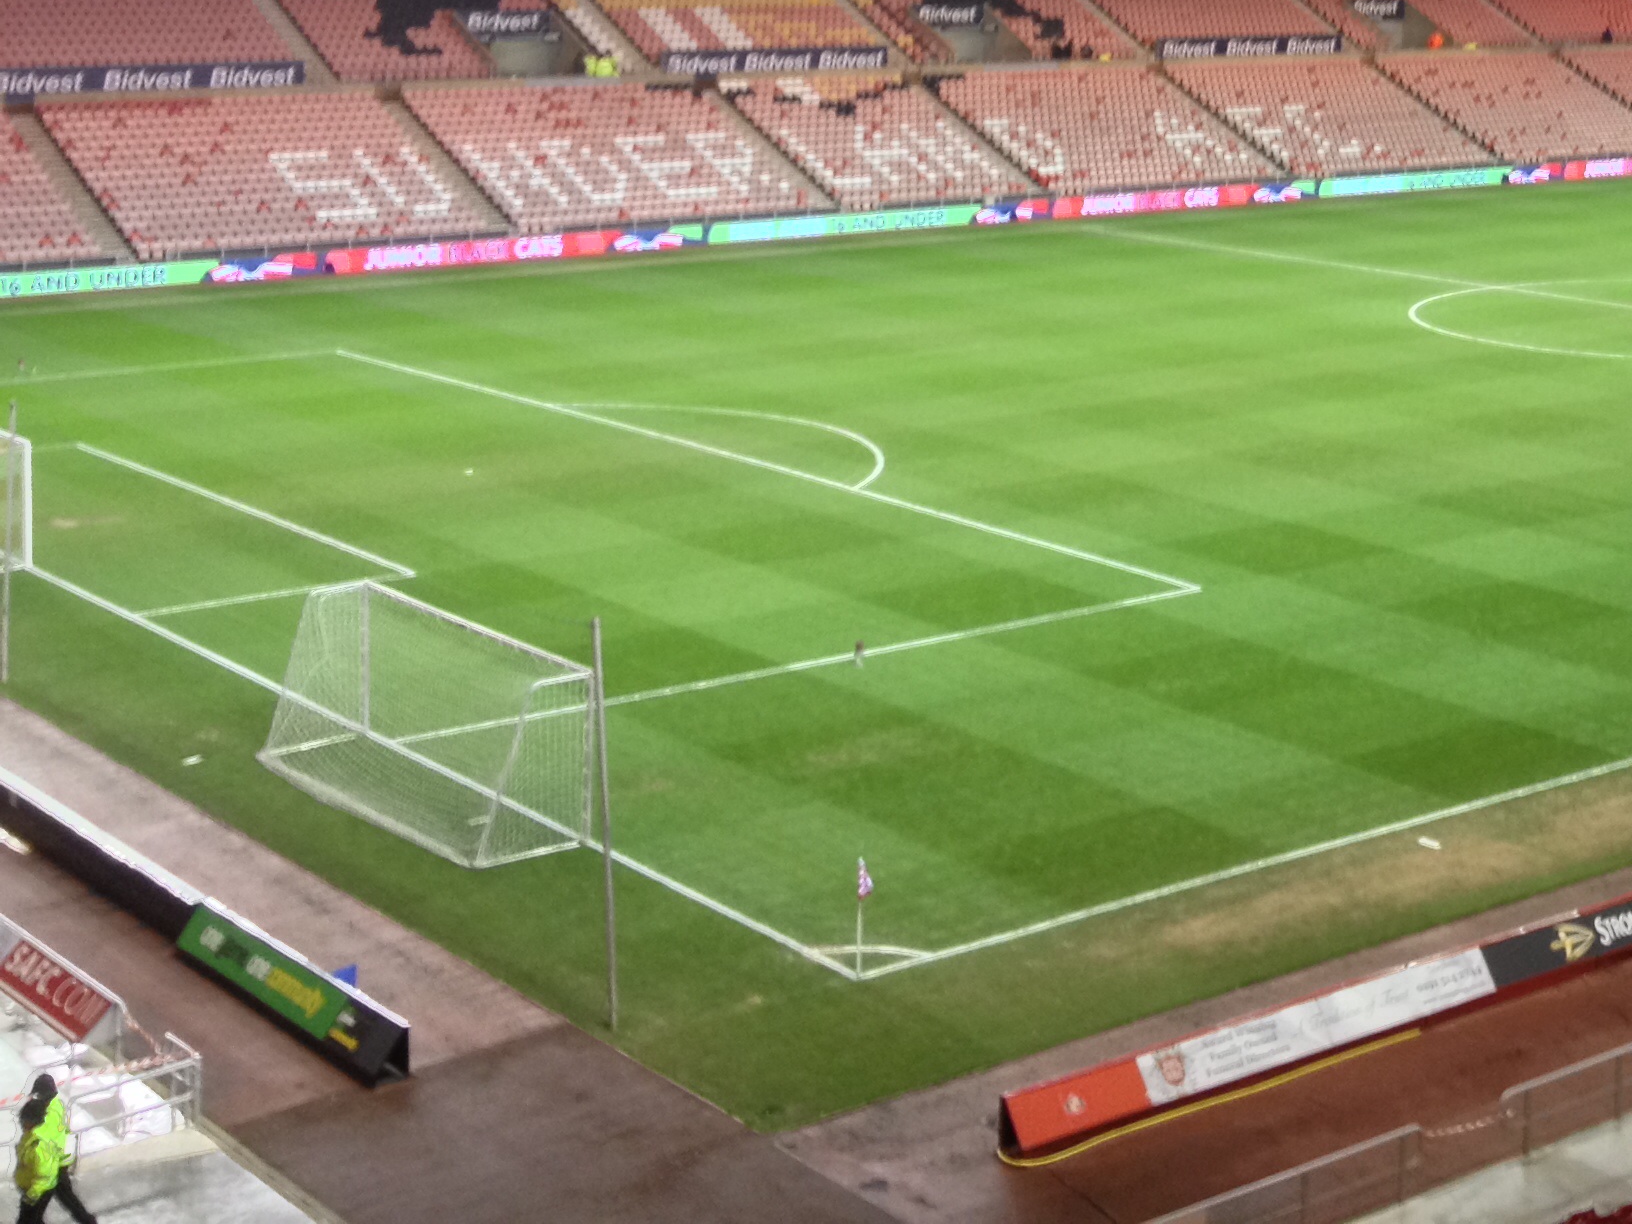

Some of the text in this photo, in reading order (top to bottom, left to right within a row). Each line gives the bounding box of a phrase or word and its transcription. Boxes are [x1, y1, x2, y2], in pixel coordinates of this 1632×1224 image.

[467, 11, 539, 32] Bidvest
[1162, 36, 1337, 59] Bidvest Bidvest Bidvest
[667, 48, 885, 74] Bidvest Bidvest Bidvest
[103, 68, 194, 92] Bidvest
[209, 64, 298, 88] Bidvest
[514, 235, 564, 259] CATS
[31, 272, 80, 294] AND
[89, 266, 167, 290] UNDER
